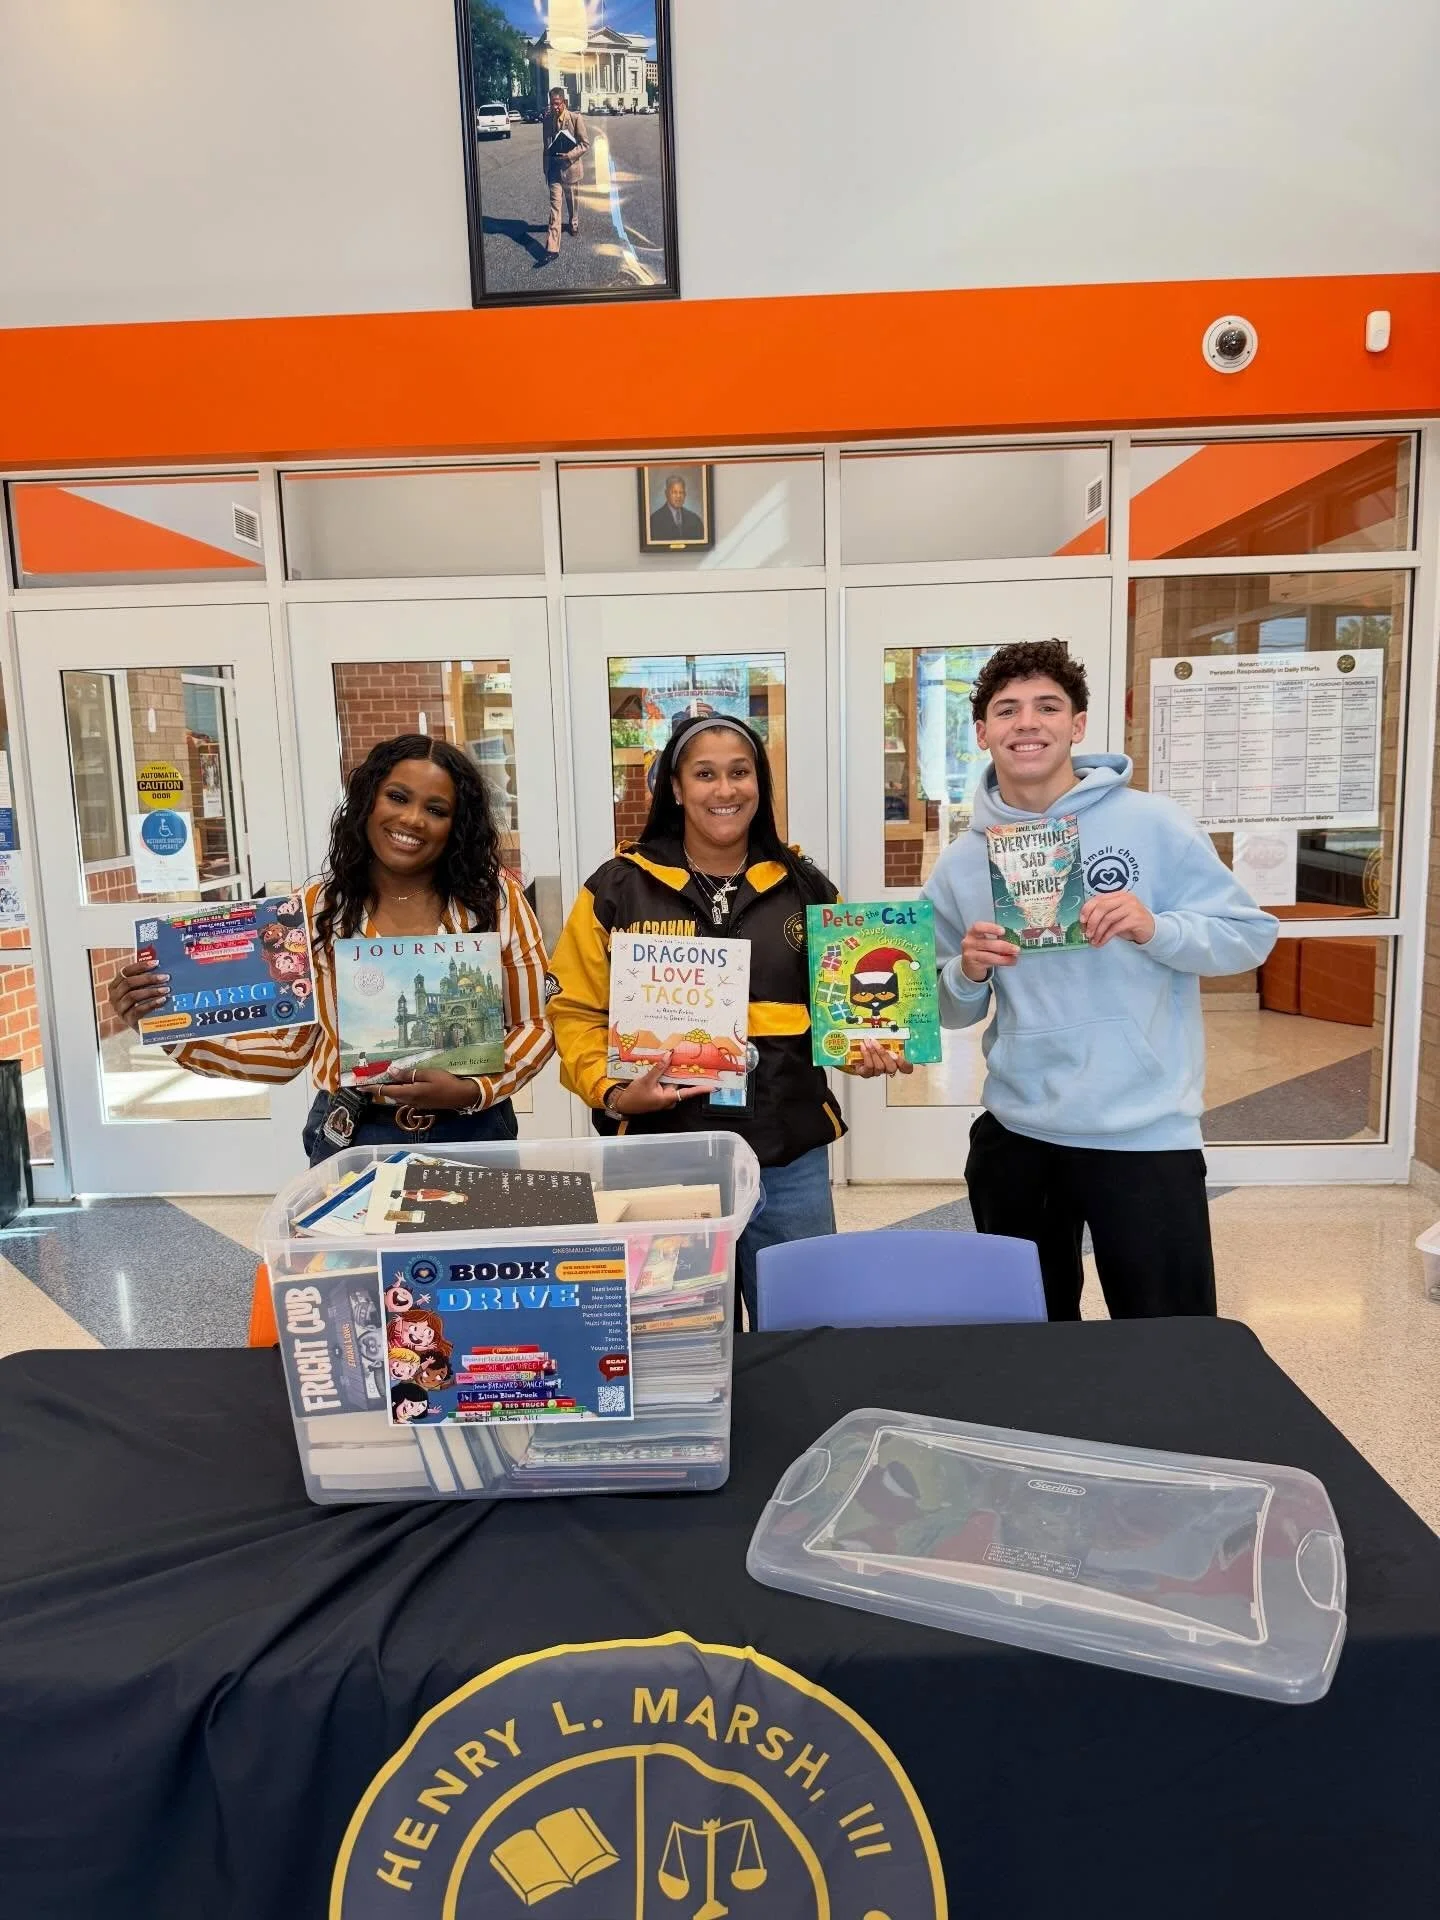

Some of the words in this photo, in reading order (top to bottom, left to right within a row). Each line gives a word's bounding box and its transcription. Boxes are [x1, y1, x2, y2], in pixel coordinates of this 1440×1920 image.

[1237, 668, 1276, 676] Responsibility
[139, 781, 181, 790] CAUTION
[141, 772, 179, 780] AUTOMATIC
[152, 792, 171, 800] DOOR
[993, 830, 1071, 853] EVERYTHING
[1020, 851, 1046, 869] SAD
[1083, 845, 1112, 866] small
[1118, 848, 1140, 882] chance
[1012, 876, 1063, 897] UNTRUE
[822, 908, 864, 928] Pete
[866, 910, 880, 919] the
[881, 907, 917, 925] Cat
[353, 940, 483, 961] JOURNEY
[878, 936, 923, 953] Christmas
[633, 943, 728, 968] DRAGONS
[651, 965, 706, 986] LOVE
[172, 981, 277, 1012] DRIVE
[641, 983, 715, 1009] TACOS
[195, 1004, 267, 1027] BOOK
[449, 1261, 549, 1282] BOOK
[437, 1284, 580, 1312] DRIVE
[284, 1286, 326, 1334] CLUB
[294, 1339, 342, 1412] FRIGHT
[488, 1382, 518, 1390] BARNYARD
[478, 1392, 498, 1400] Little
[1031, 1480, 1081, 1494] Sterilite
[376, 1718, 523, 1893] HENRY
[551, 1698, 605, 1738] L.
[632, 1686, 831, 1803] MARSH,
[838, 1801, 893, 1859] III
